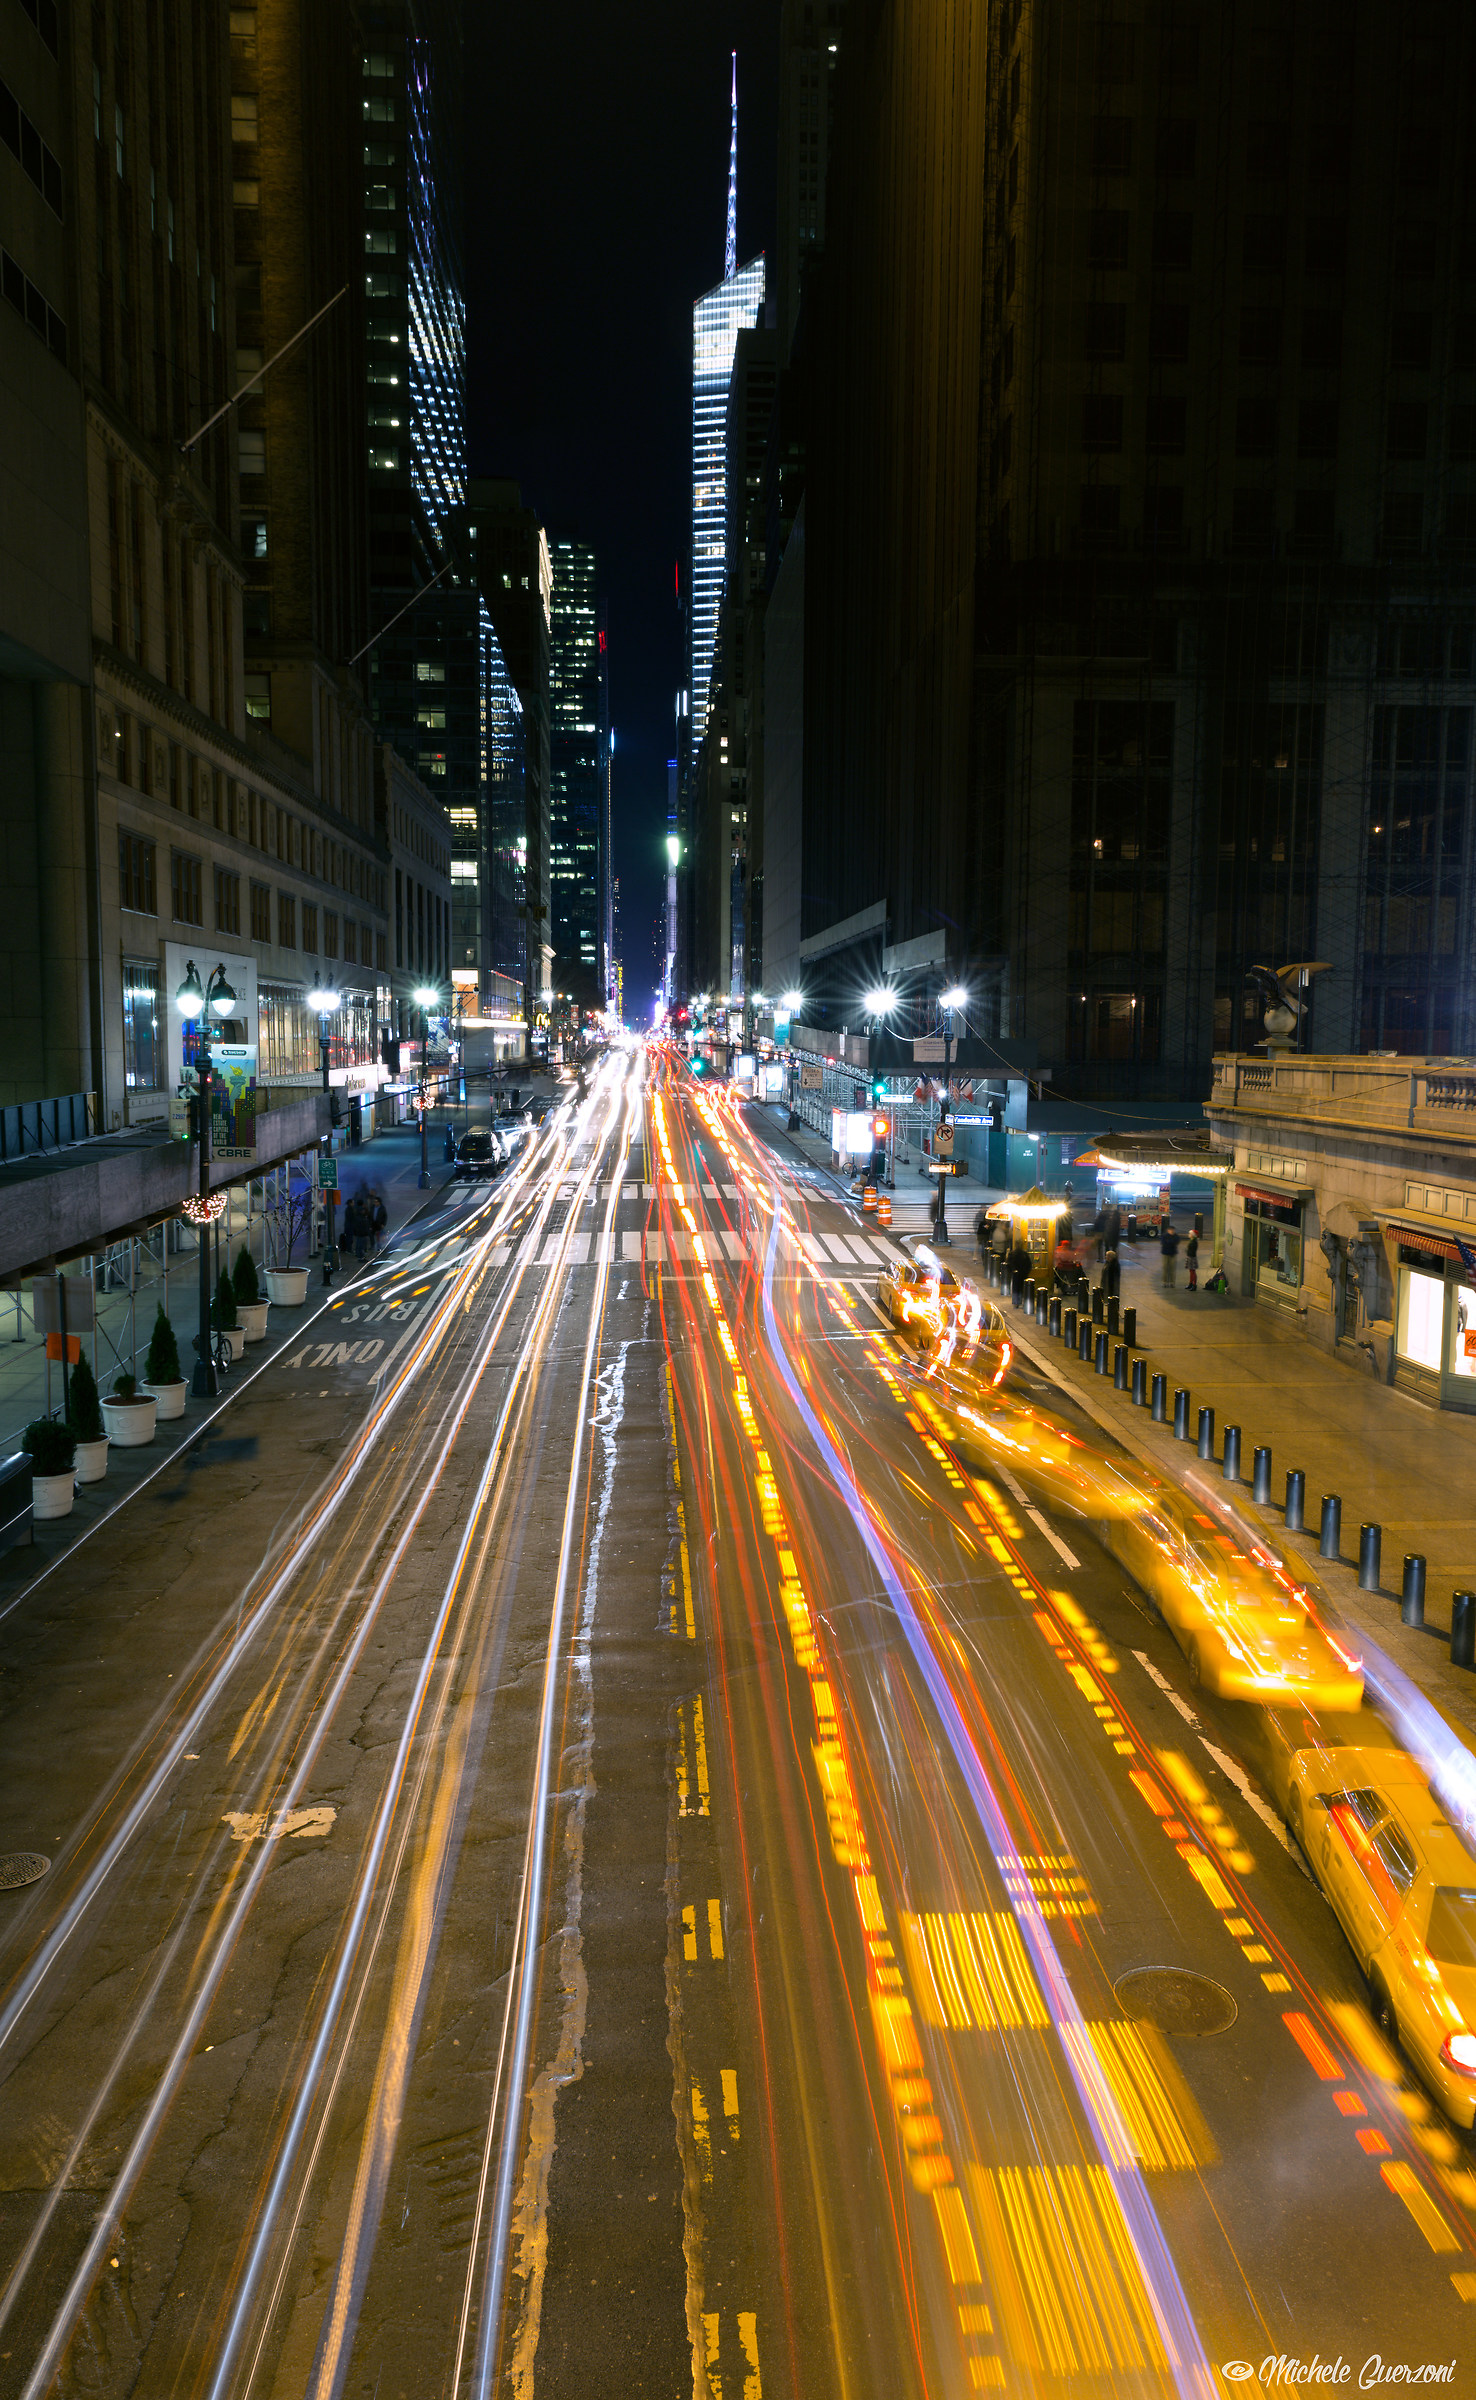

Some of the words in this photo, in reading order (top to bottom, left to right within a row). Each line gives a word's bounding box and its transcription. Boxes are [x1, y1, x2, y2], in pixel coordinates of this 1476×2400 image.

[217, 1149, 251, 1158] CBRE
[341, 1301, 419, 1323] BUS
[281, 1339, 385, 1368] ONLY
